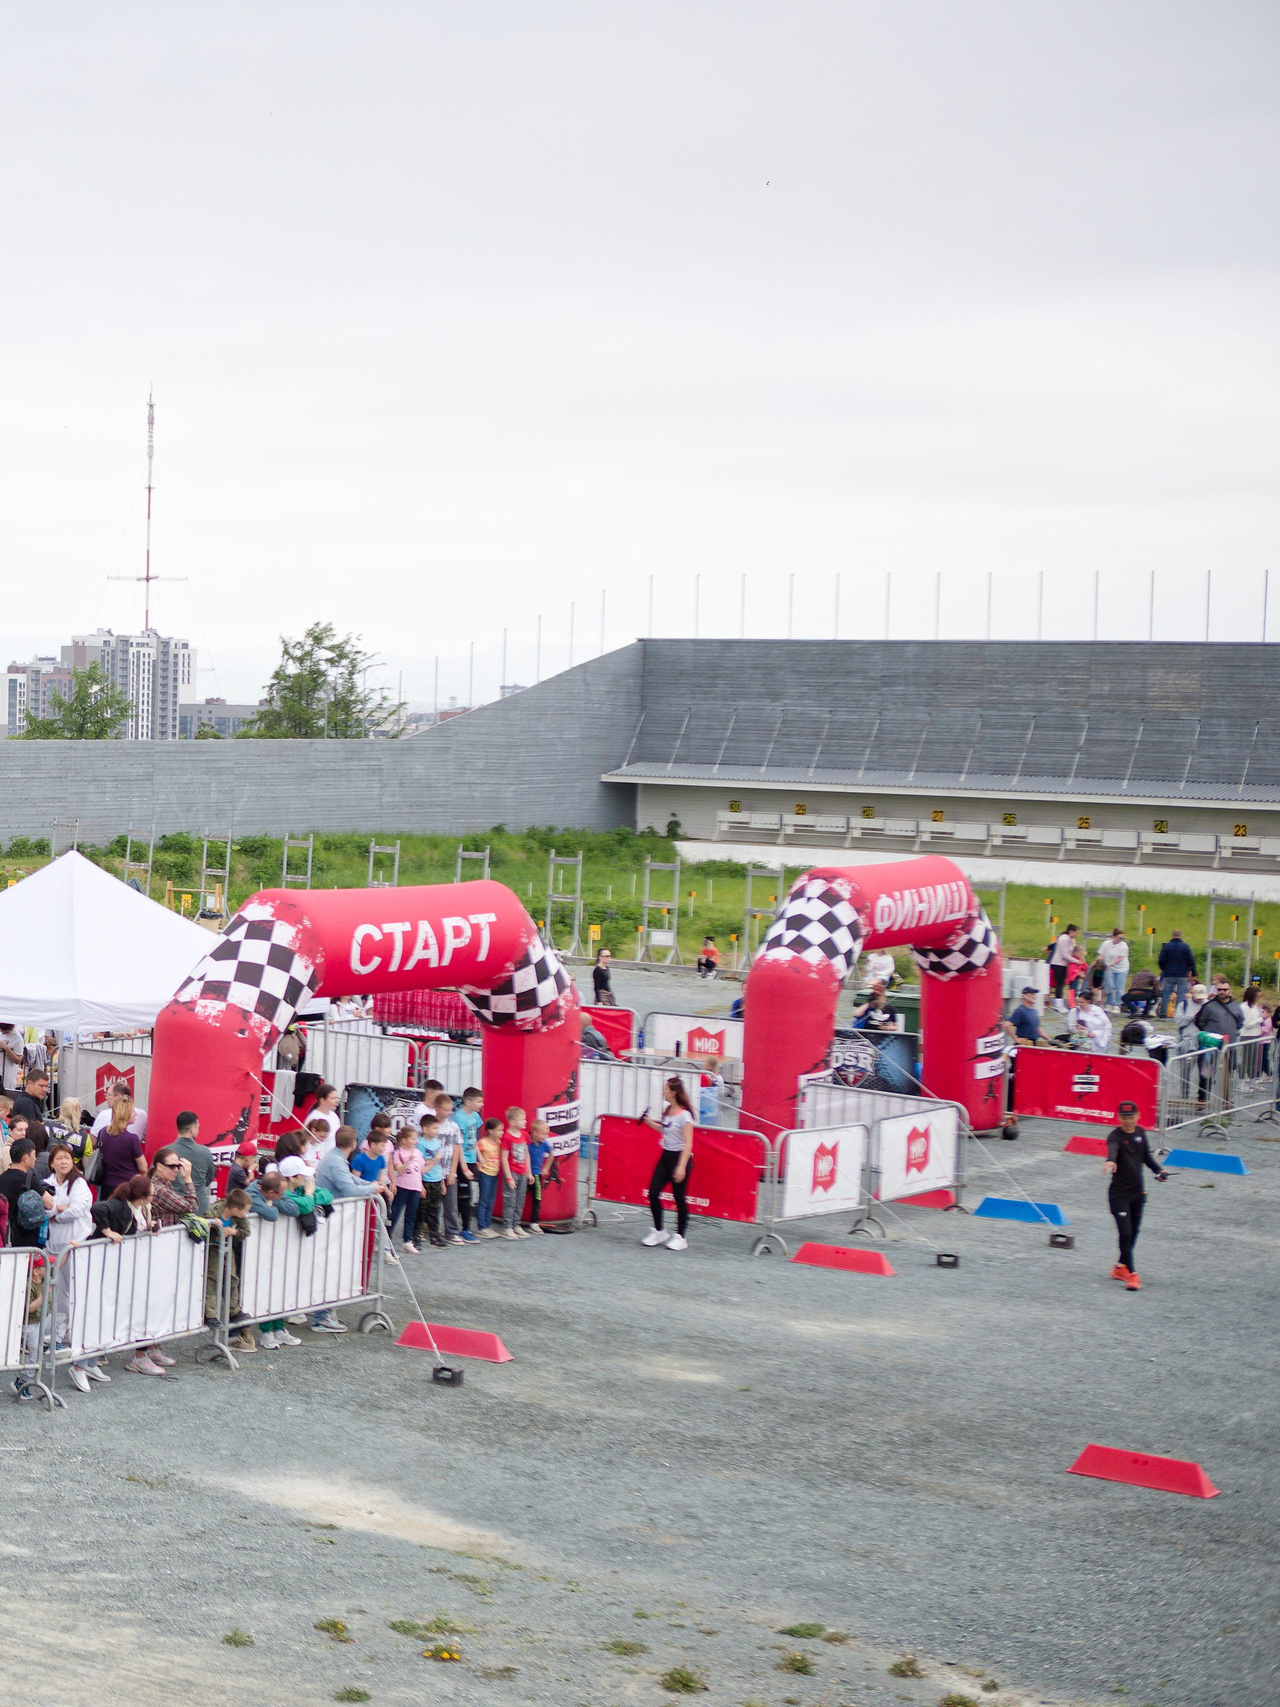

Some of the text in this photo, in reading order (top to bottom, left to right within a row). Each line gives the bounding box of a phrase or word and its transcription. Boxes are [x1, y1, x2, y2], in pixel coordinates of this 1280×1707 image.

[730, 801, 741, 812] 30
[795, 804, 806, 815] 29
[1078, 817, 1091, 829] 25
[1155, 821, 1168, 833] 24
[1234, 824, 1247, 836] 23
[874, 881, 968, 933] ФИНИШ
[350, 912, 498, 976] СТАРТ
[693, 1036, 720, 1053] МИР
[830, 1051, 873, 1073] DSR
